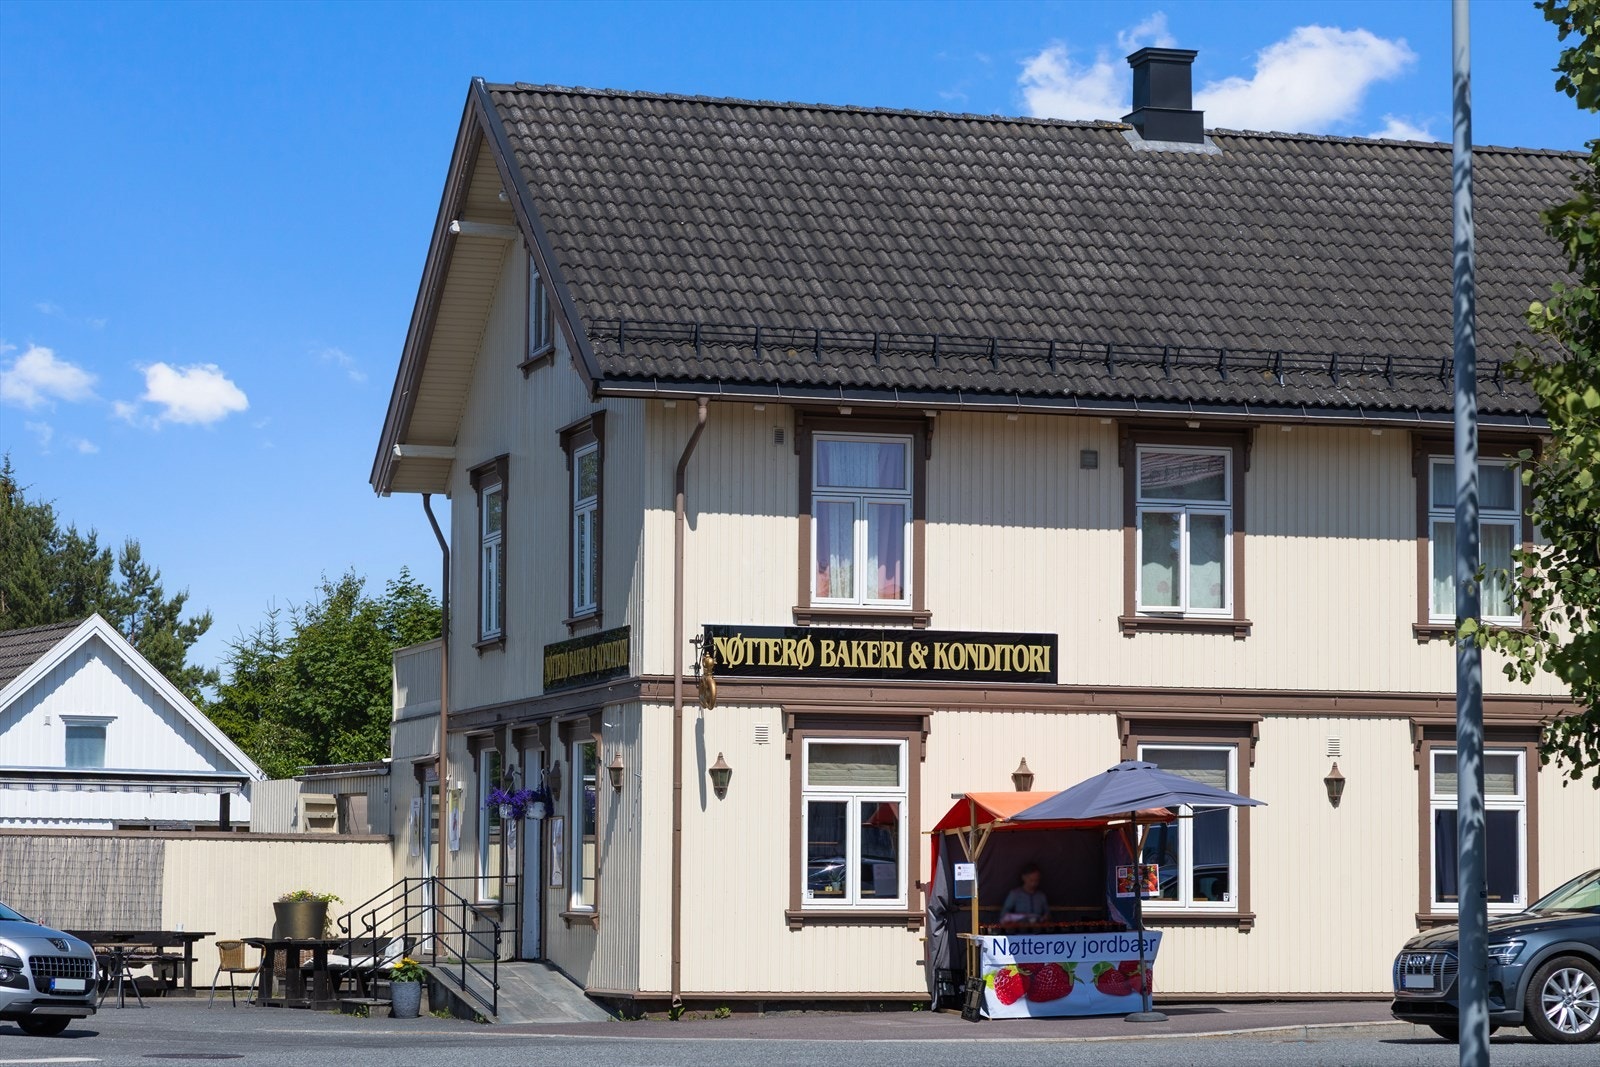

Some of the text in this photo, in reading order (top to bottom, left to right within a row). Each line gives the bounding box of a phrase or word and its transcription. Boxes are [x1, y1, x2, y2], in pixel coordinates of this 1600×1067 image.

[713, 633, 1051, 673] NØTTERØ BAKERI & KONDITORI
[993, 935, 1156, 958] Nøtterøy jordbær
